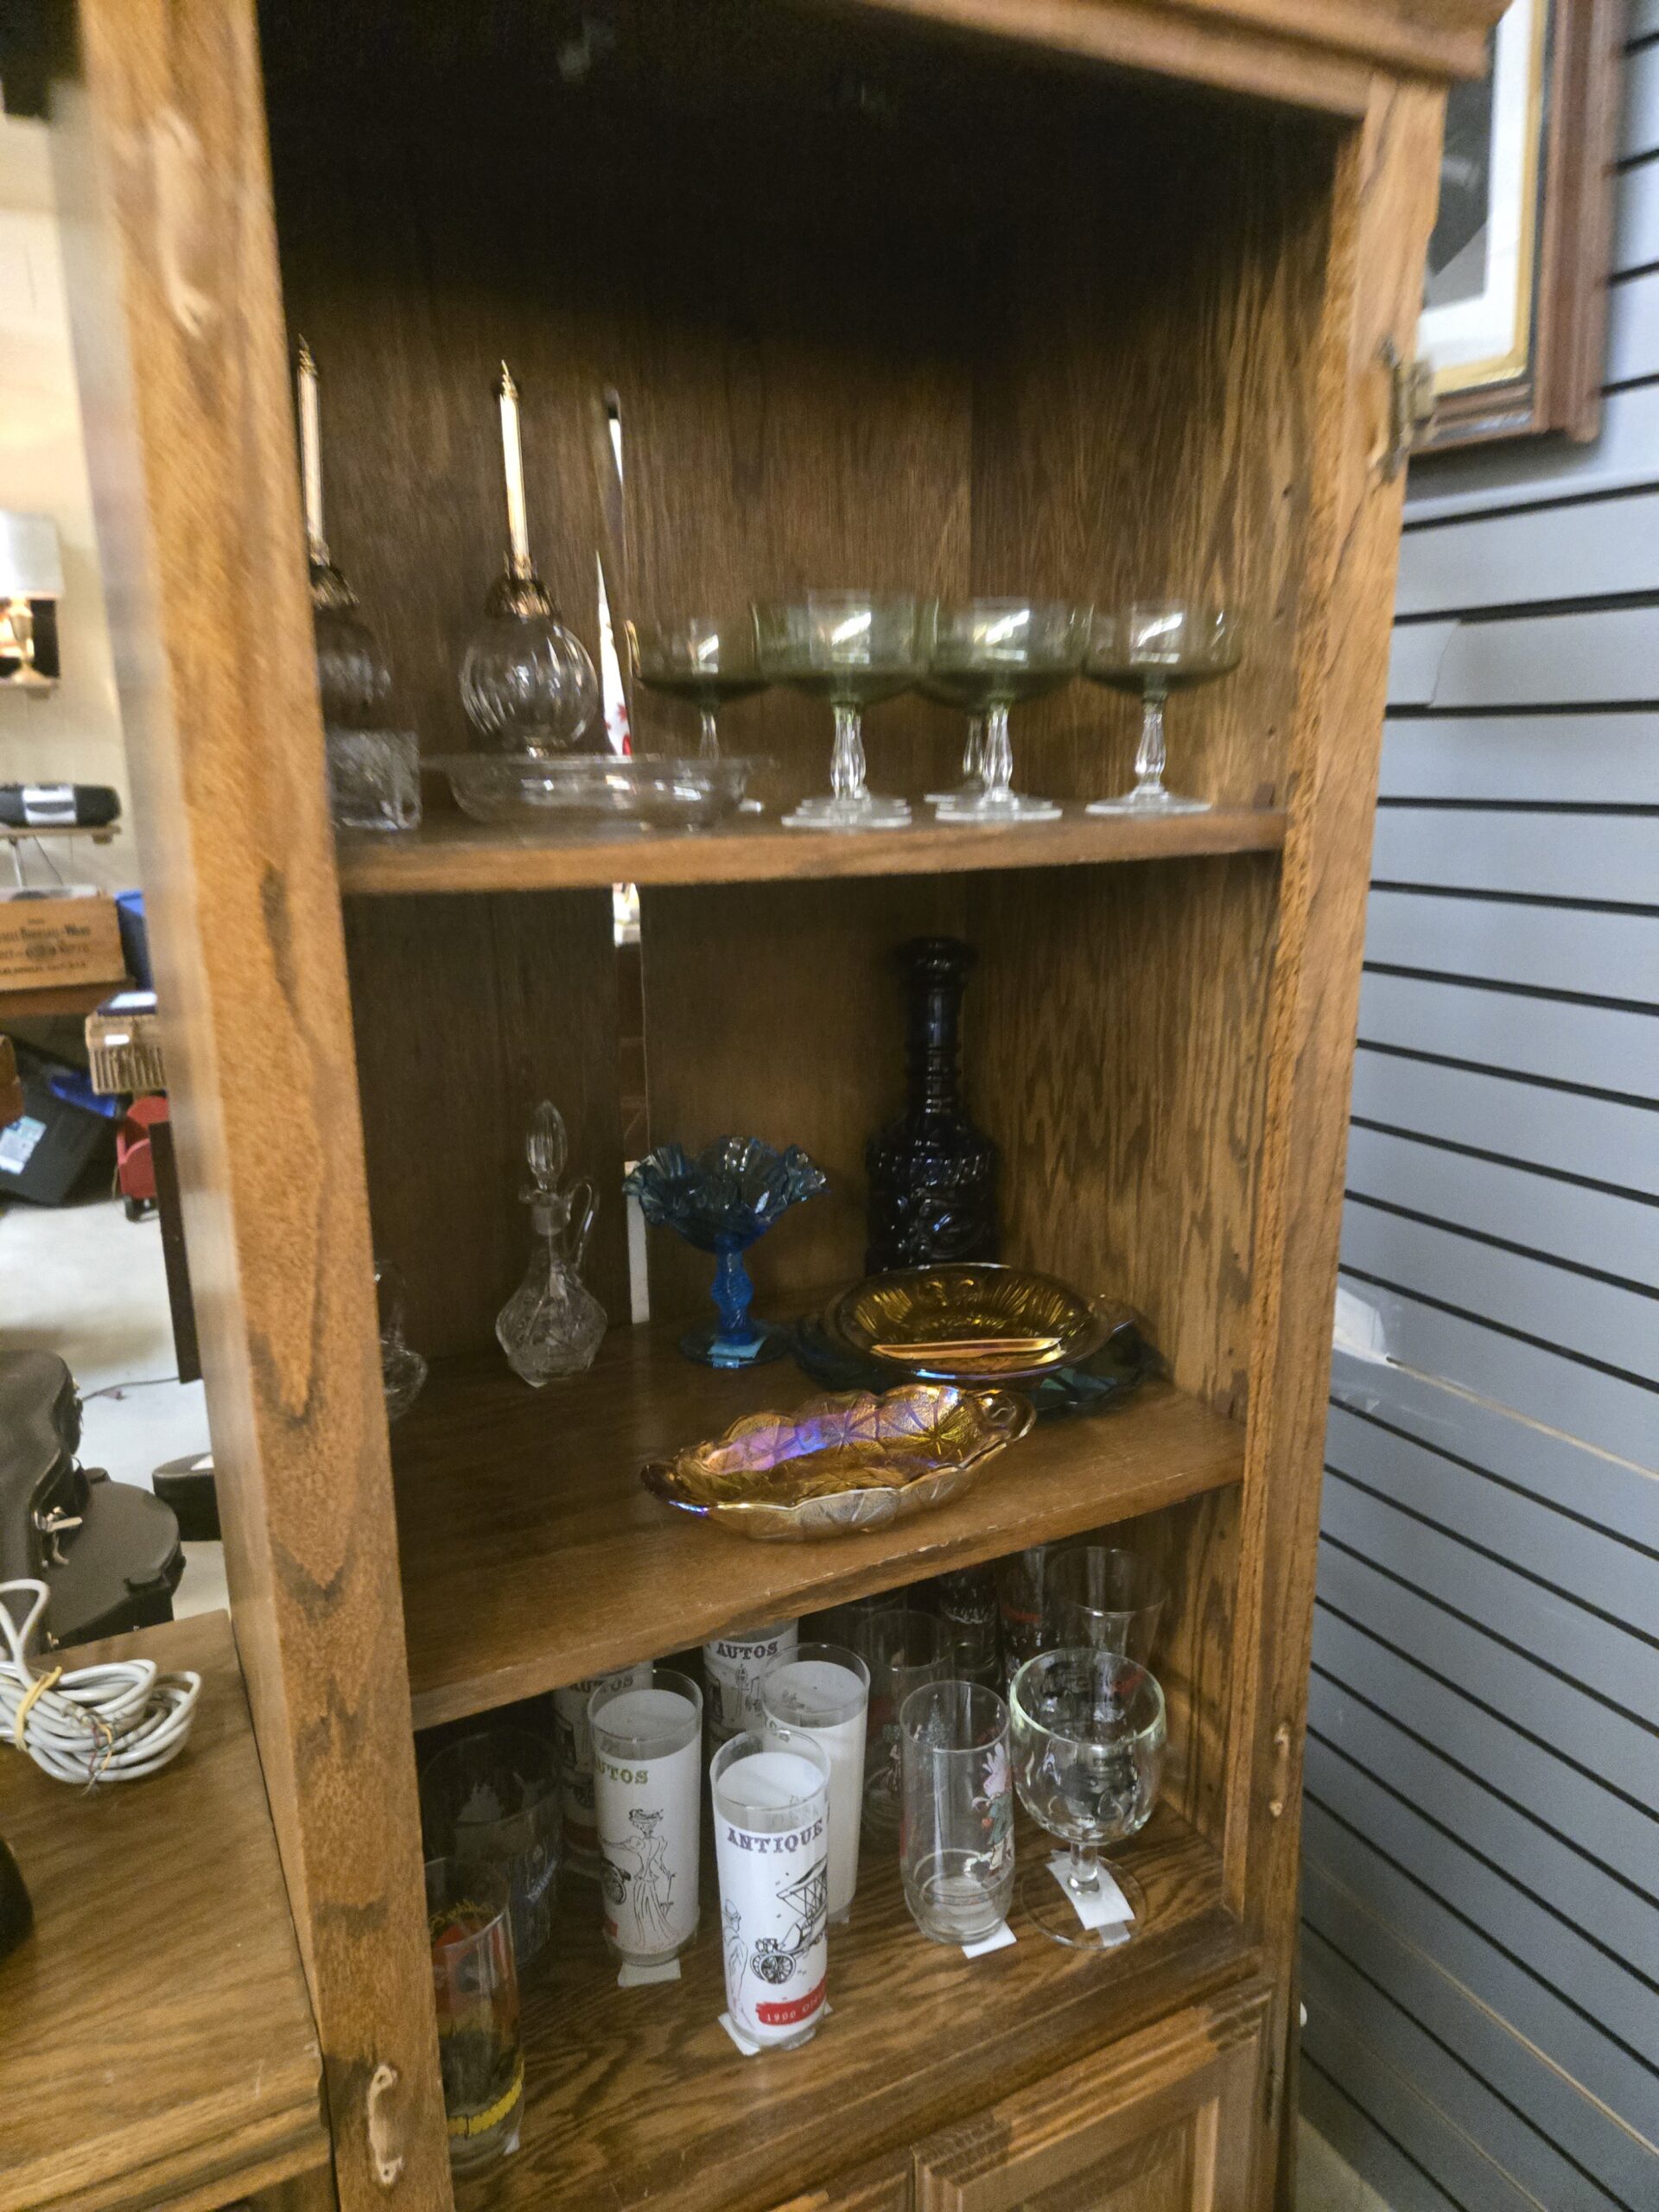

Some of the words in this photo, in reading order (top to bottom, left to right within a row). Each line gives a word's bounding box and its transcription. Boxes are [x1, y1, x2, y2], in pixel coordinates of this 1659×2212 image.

[716, 1642, 778, 1660] AUTOS
[728, 1817, 823, 1853] ANTIQUE
[766, 2010, 797, 2022] 1900
